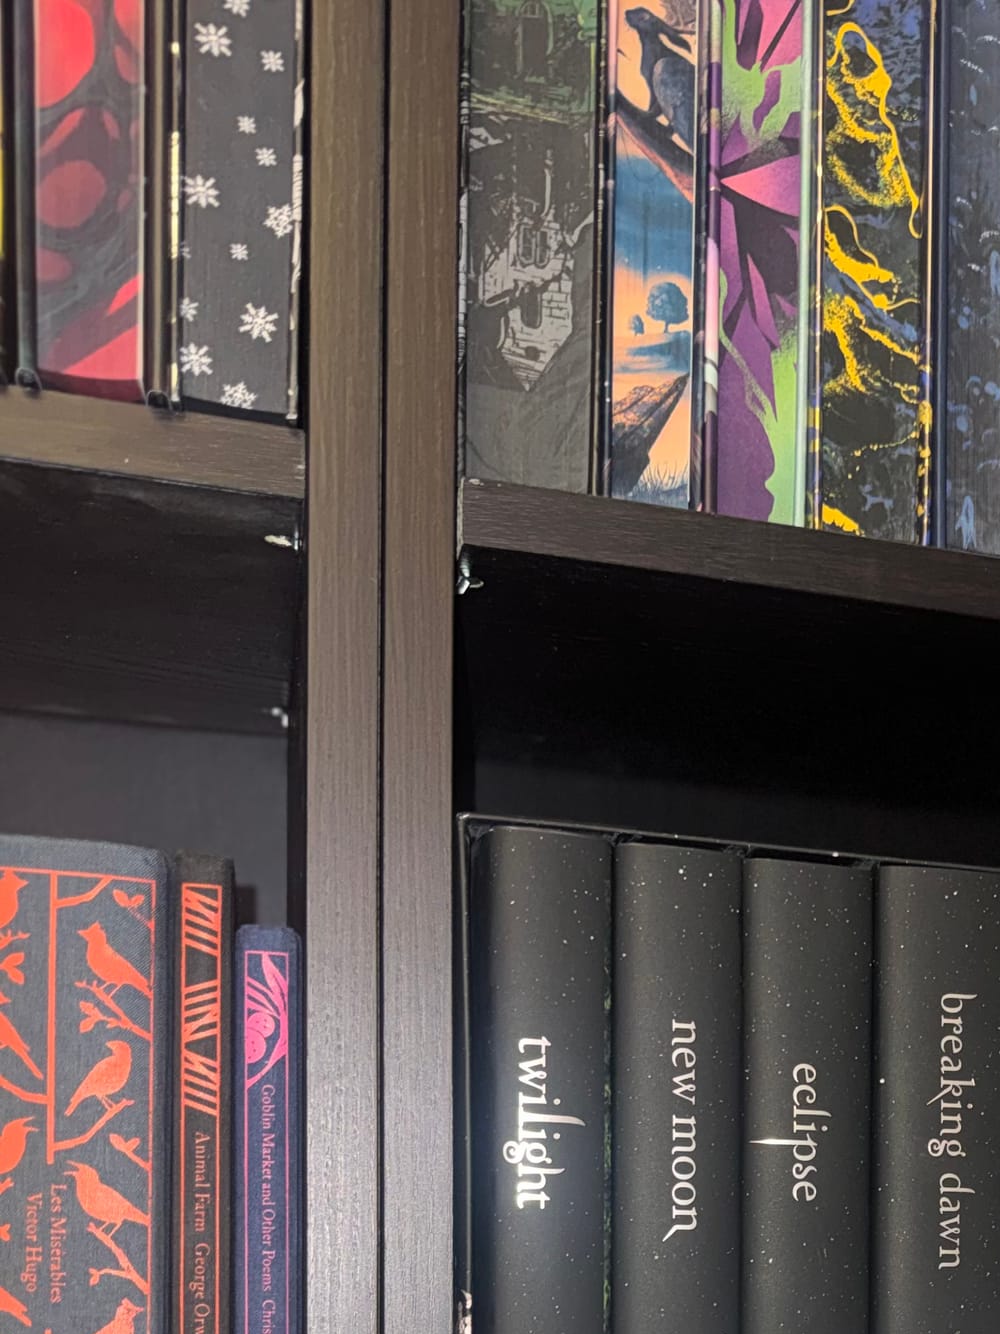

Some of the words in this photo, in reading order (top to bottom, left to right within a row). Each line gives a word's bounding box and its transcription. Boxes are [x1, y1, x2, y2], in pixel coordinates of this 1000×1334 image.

[671, 1020, 699, 1104] new
[927, 993, 976, 1158] breaking
[262, 1084, 276, 1129] Goblin
[504, 1036, 585, 1209] twilight
[750, 1063, 831, 1202] eclipse
[194, 1132, 210, 1187] Animal
[262, 1133, 275, 1180] Market
[662, 1114, 702, 1242] moon
[24, 1193, 42, 1242] Victor
[50, 1184, 66, 1213] Les
[195, 1193, 209, 1231] Farm
[262, 1183, 276, 1205] and
[262, 1208, 275, 1246] Other
[937, 1173, 975, 1269] dawn
[22, 1246, 41, 1292] Hugo
[50, 1217, 66, 1303] Misérables
[190, 1243, 210, 1298] George
[262, 1250, 275, 1291] Poems
